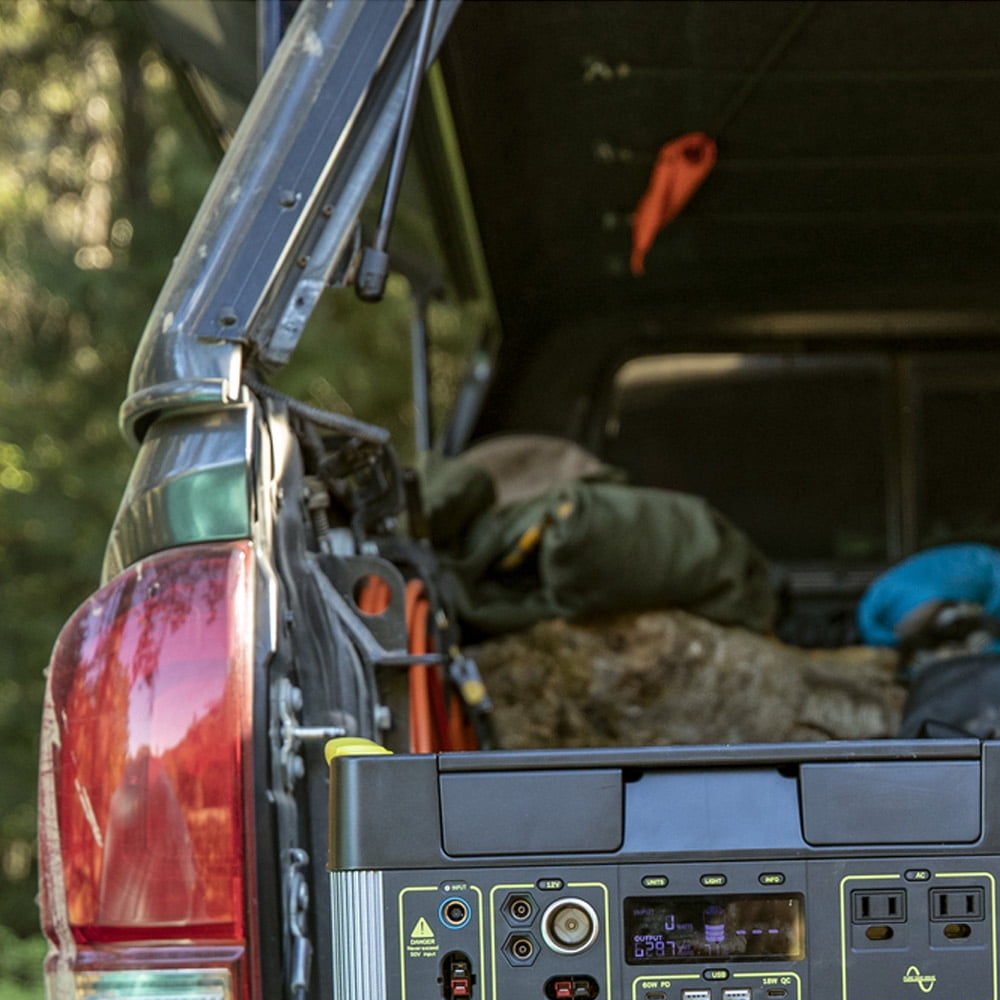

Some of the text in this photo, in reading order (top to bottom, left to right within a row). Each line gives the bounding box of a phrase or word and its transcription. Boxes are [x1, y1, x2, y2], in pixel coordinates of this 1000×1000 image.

[915, 871, 926, 879] AC
[703, 877, 723, 885] LIGHT
[451, 883, 468, 891] INPUT
[711, 970, 727, 978] USB
[780, 976, 791, 985] QC
